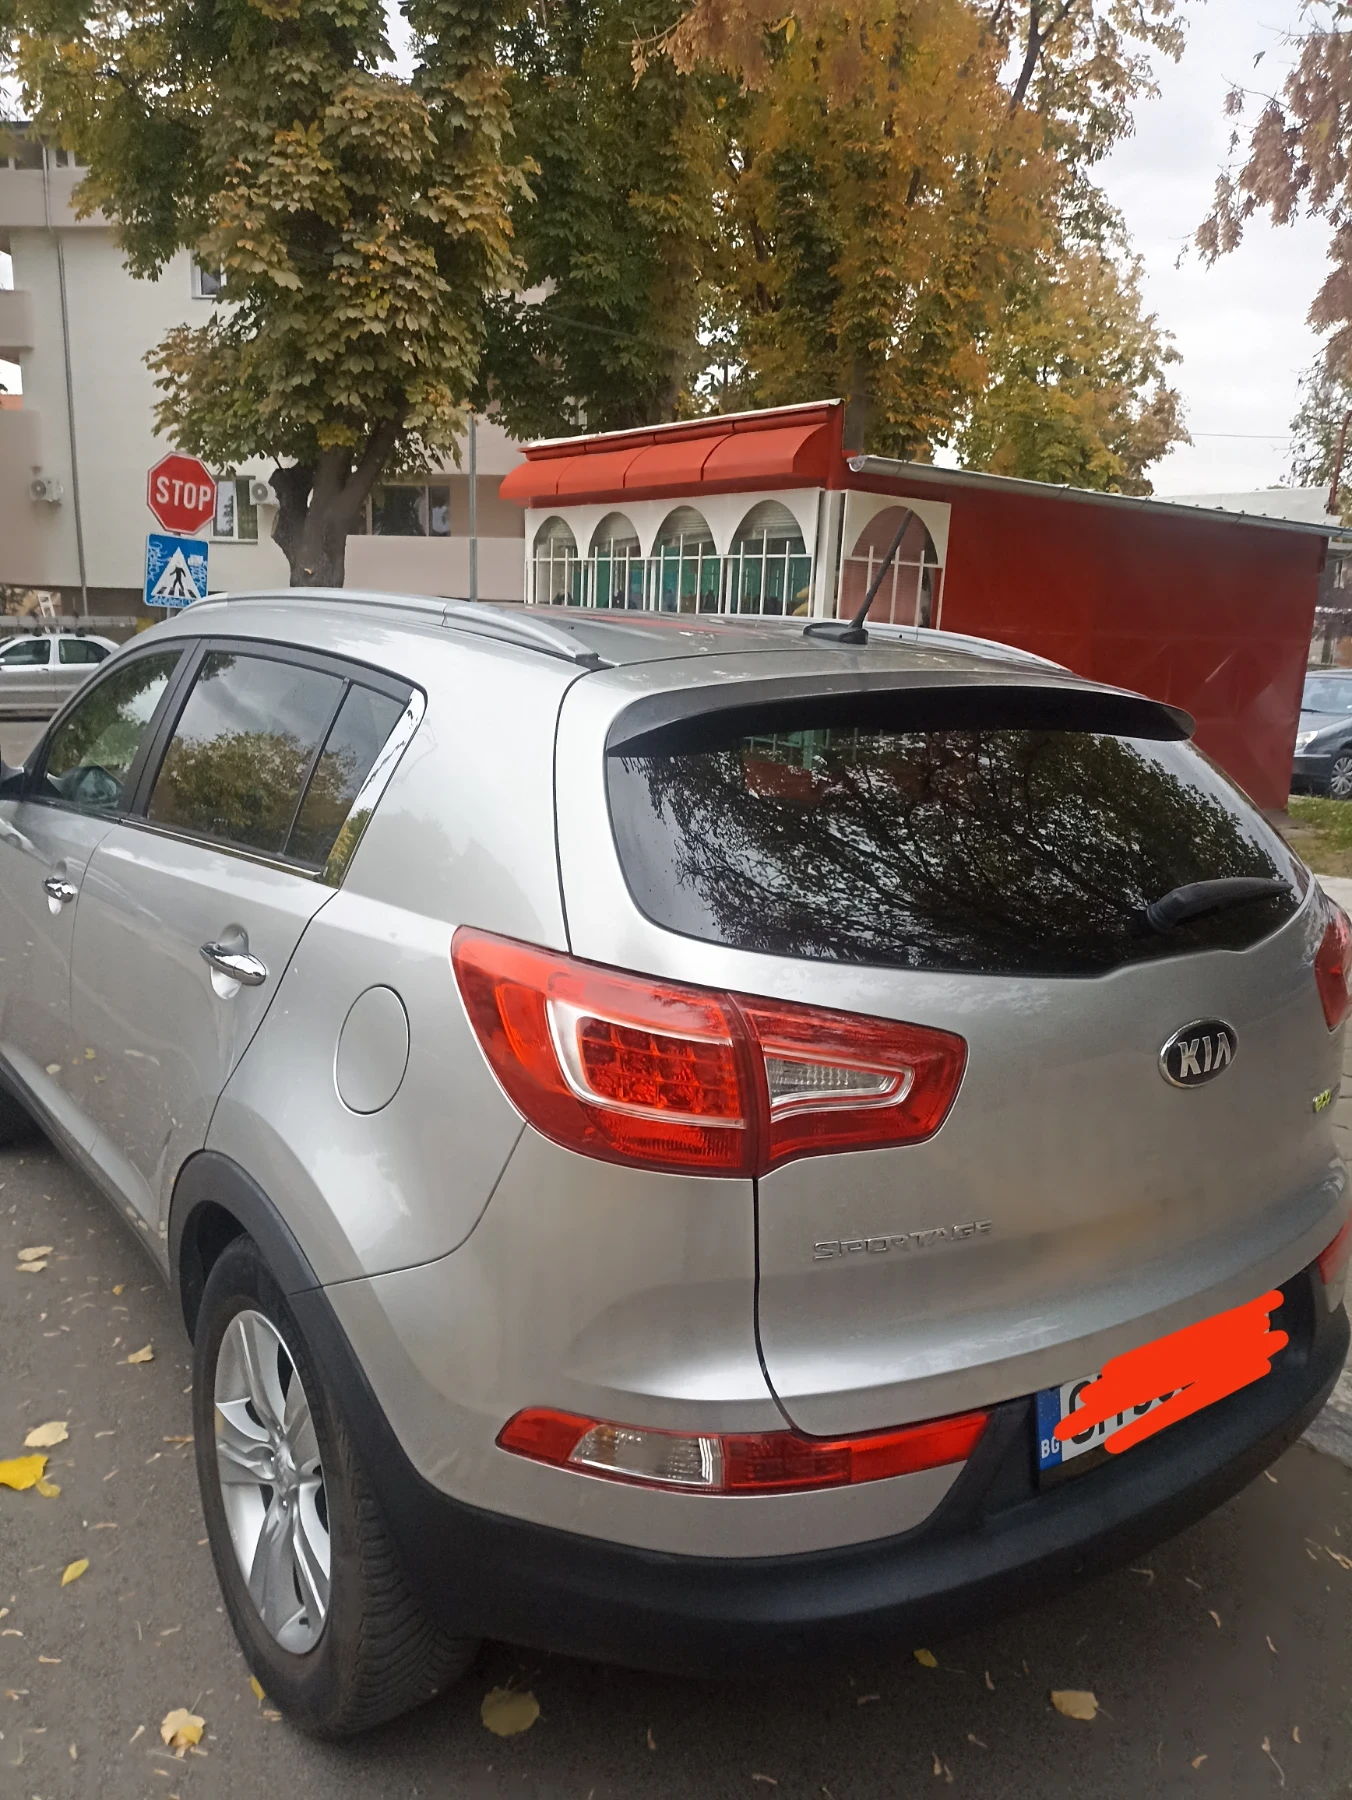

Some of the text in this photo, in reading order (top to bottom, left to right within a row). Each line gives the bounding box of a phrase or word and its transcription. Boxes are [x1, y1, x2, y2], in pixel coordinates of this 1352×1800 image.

[156, 476, 211, 511] STOP
[1178, 1031, 1231, 1078] KIA
[813, 1219, 993, 1261] SPORTAGE
[1041, 1436, 1060, 1459] BG
